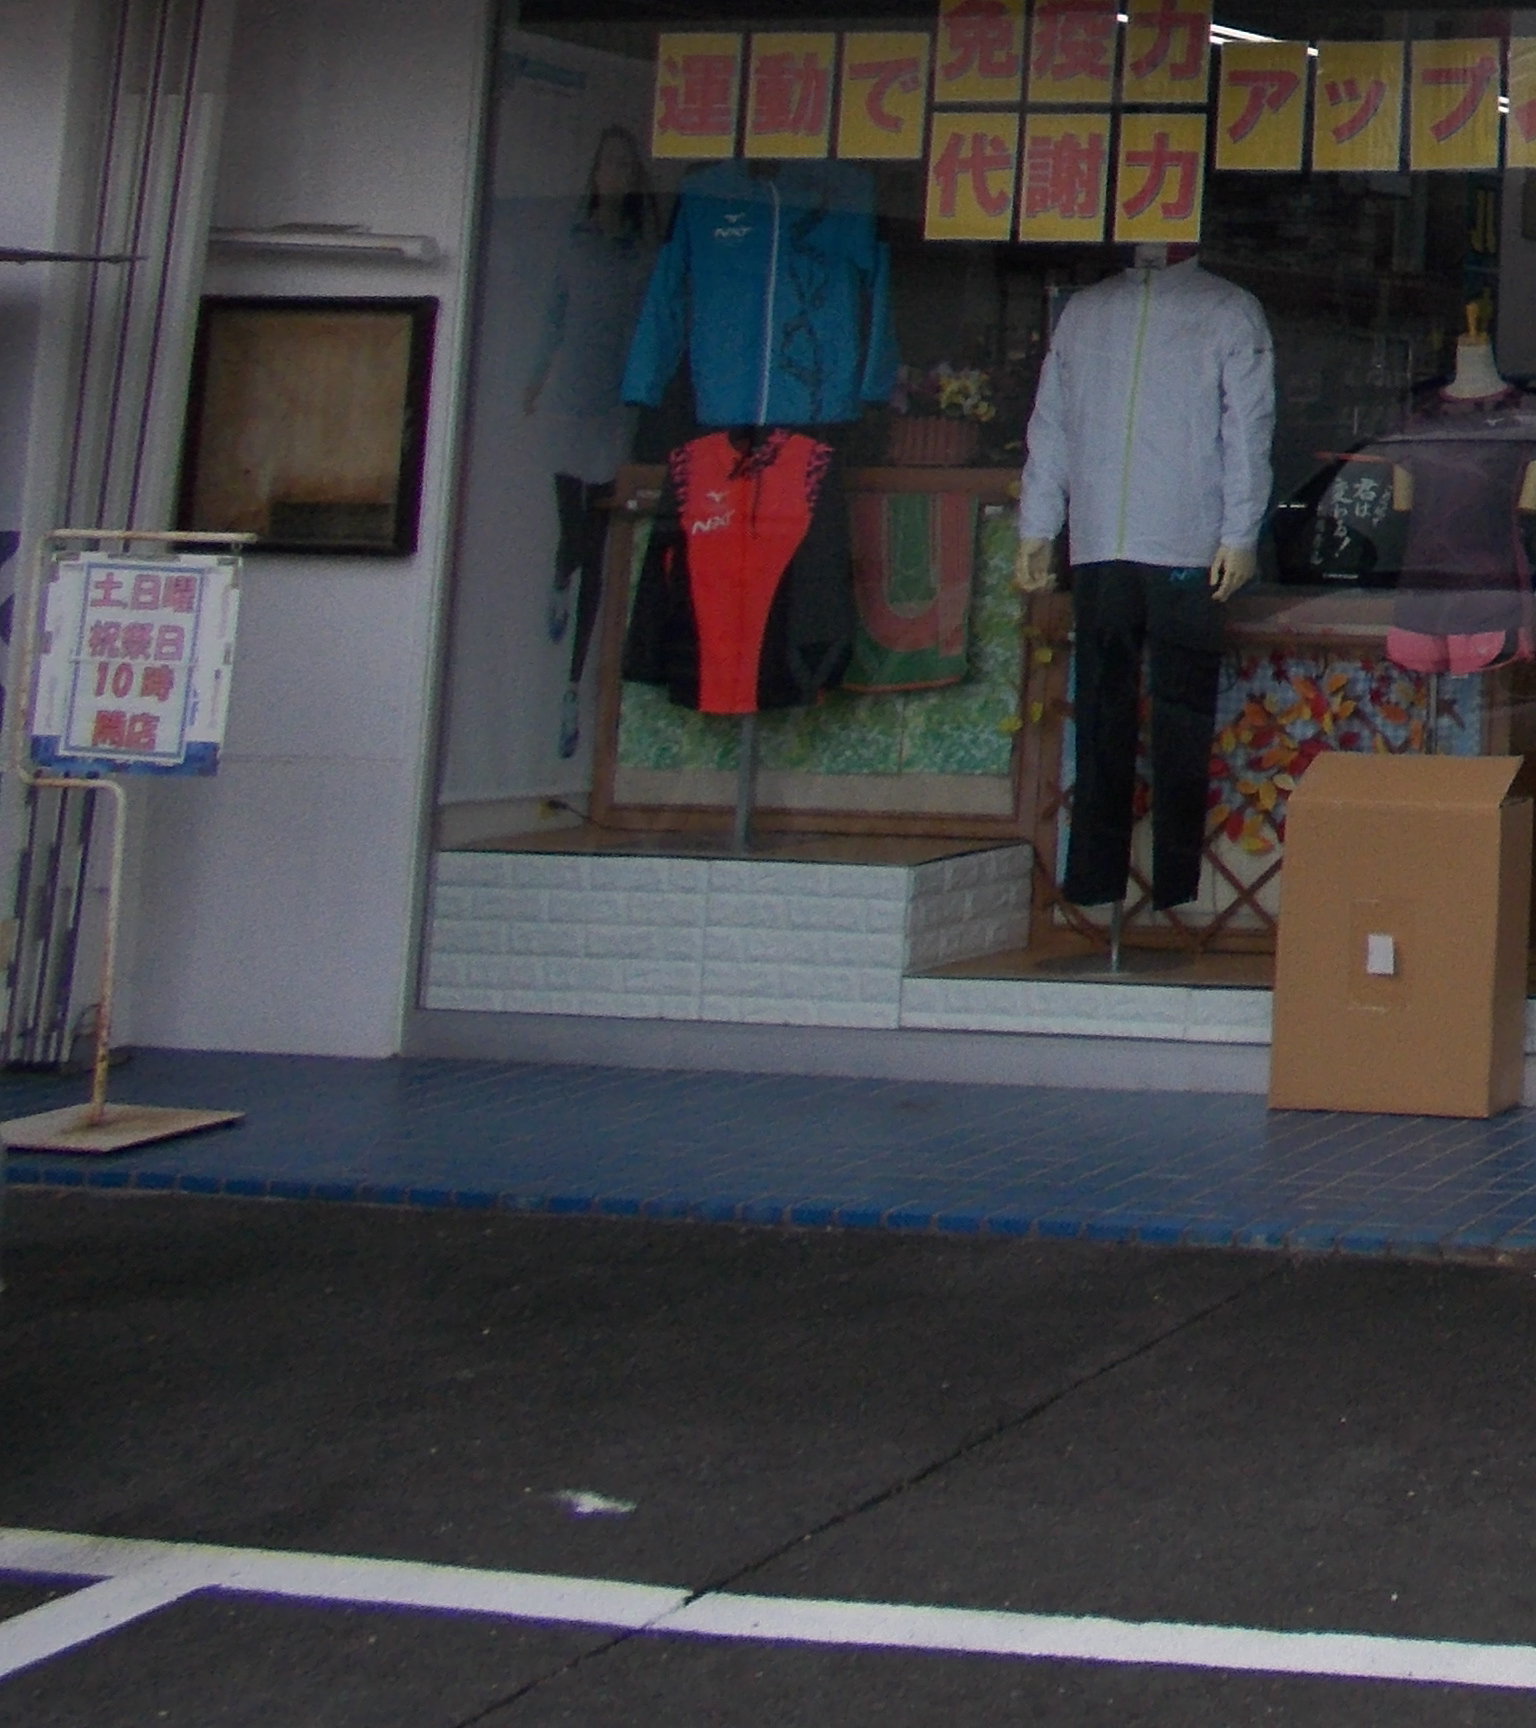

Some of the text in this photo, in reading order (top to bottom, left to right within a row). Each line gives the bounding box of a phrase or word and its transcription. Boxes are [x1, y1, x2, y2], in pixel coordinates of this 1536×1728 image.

[659, 52, 919, 138] 運動で
[934, 131, 1198, 221] 代謝力
[93, 662, 176, 703] 10時
